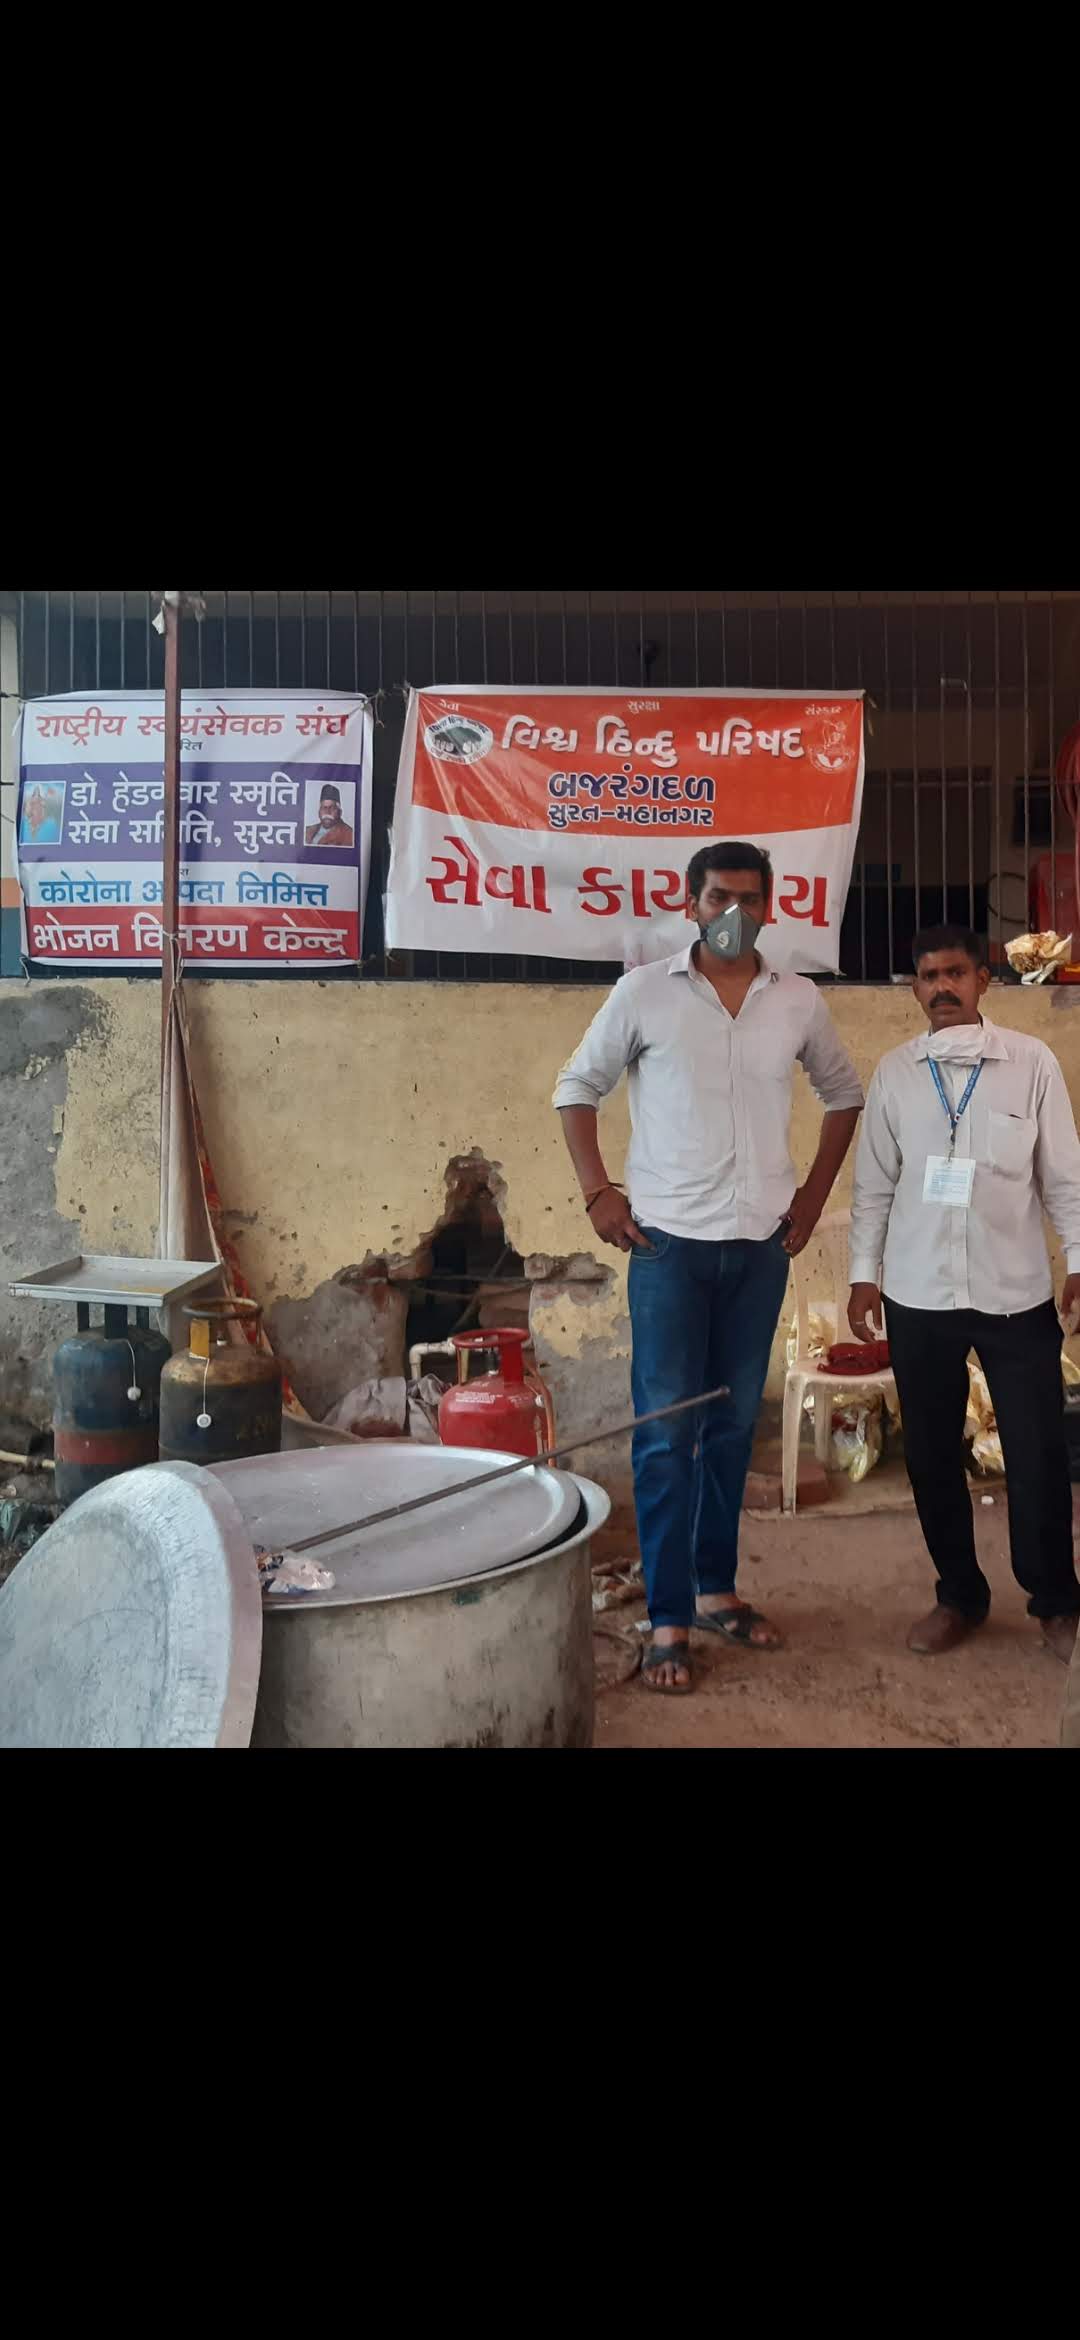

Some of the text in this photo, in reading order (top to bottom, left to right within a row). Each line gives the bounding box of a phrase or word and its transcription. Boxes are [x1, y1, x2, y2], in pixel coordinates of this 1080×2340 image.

[36, 706, 127, 746] राष्ट्रीय
[296, 706, 349, 737] संघ
[501, 715, 578, 753] વિશ્વ
[596, 715, 679, 768] હિન્દુ
[696, 717, 805, 758] પરિષદ
[229, 771, 300, 815] स्मृति
[548, 763, 716, 802] બજરંગદળ
[68, 811, 120, 844] सेवा
[233, 820, 298, 854] सुरत
[39, 870, 132, 904] कोरोना
[237, 871, 329, 906] निमित्त
[426, 836, 552, 913] સેવા
[33, 912, 120, 951] भोजन
[262, 913, 348, 955] केन्द्र
